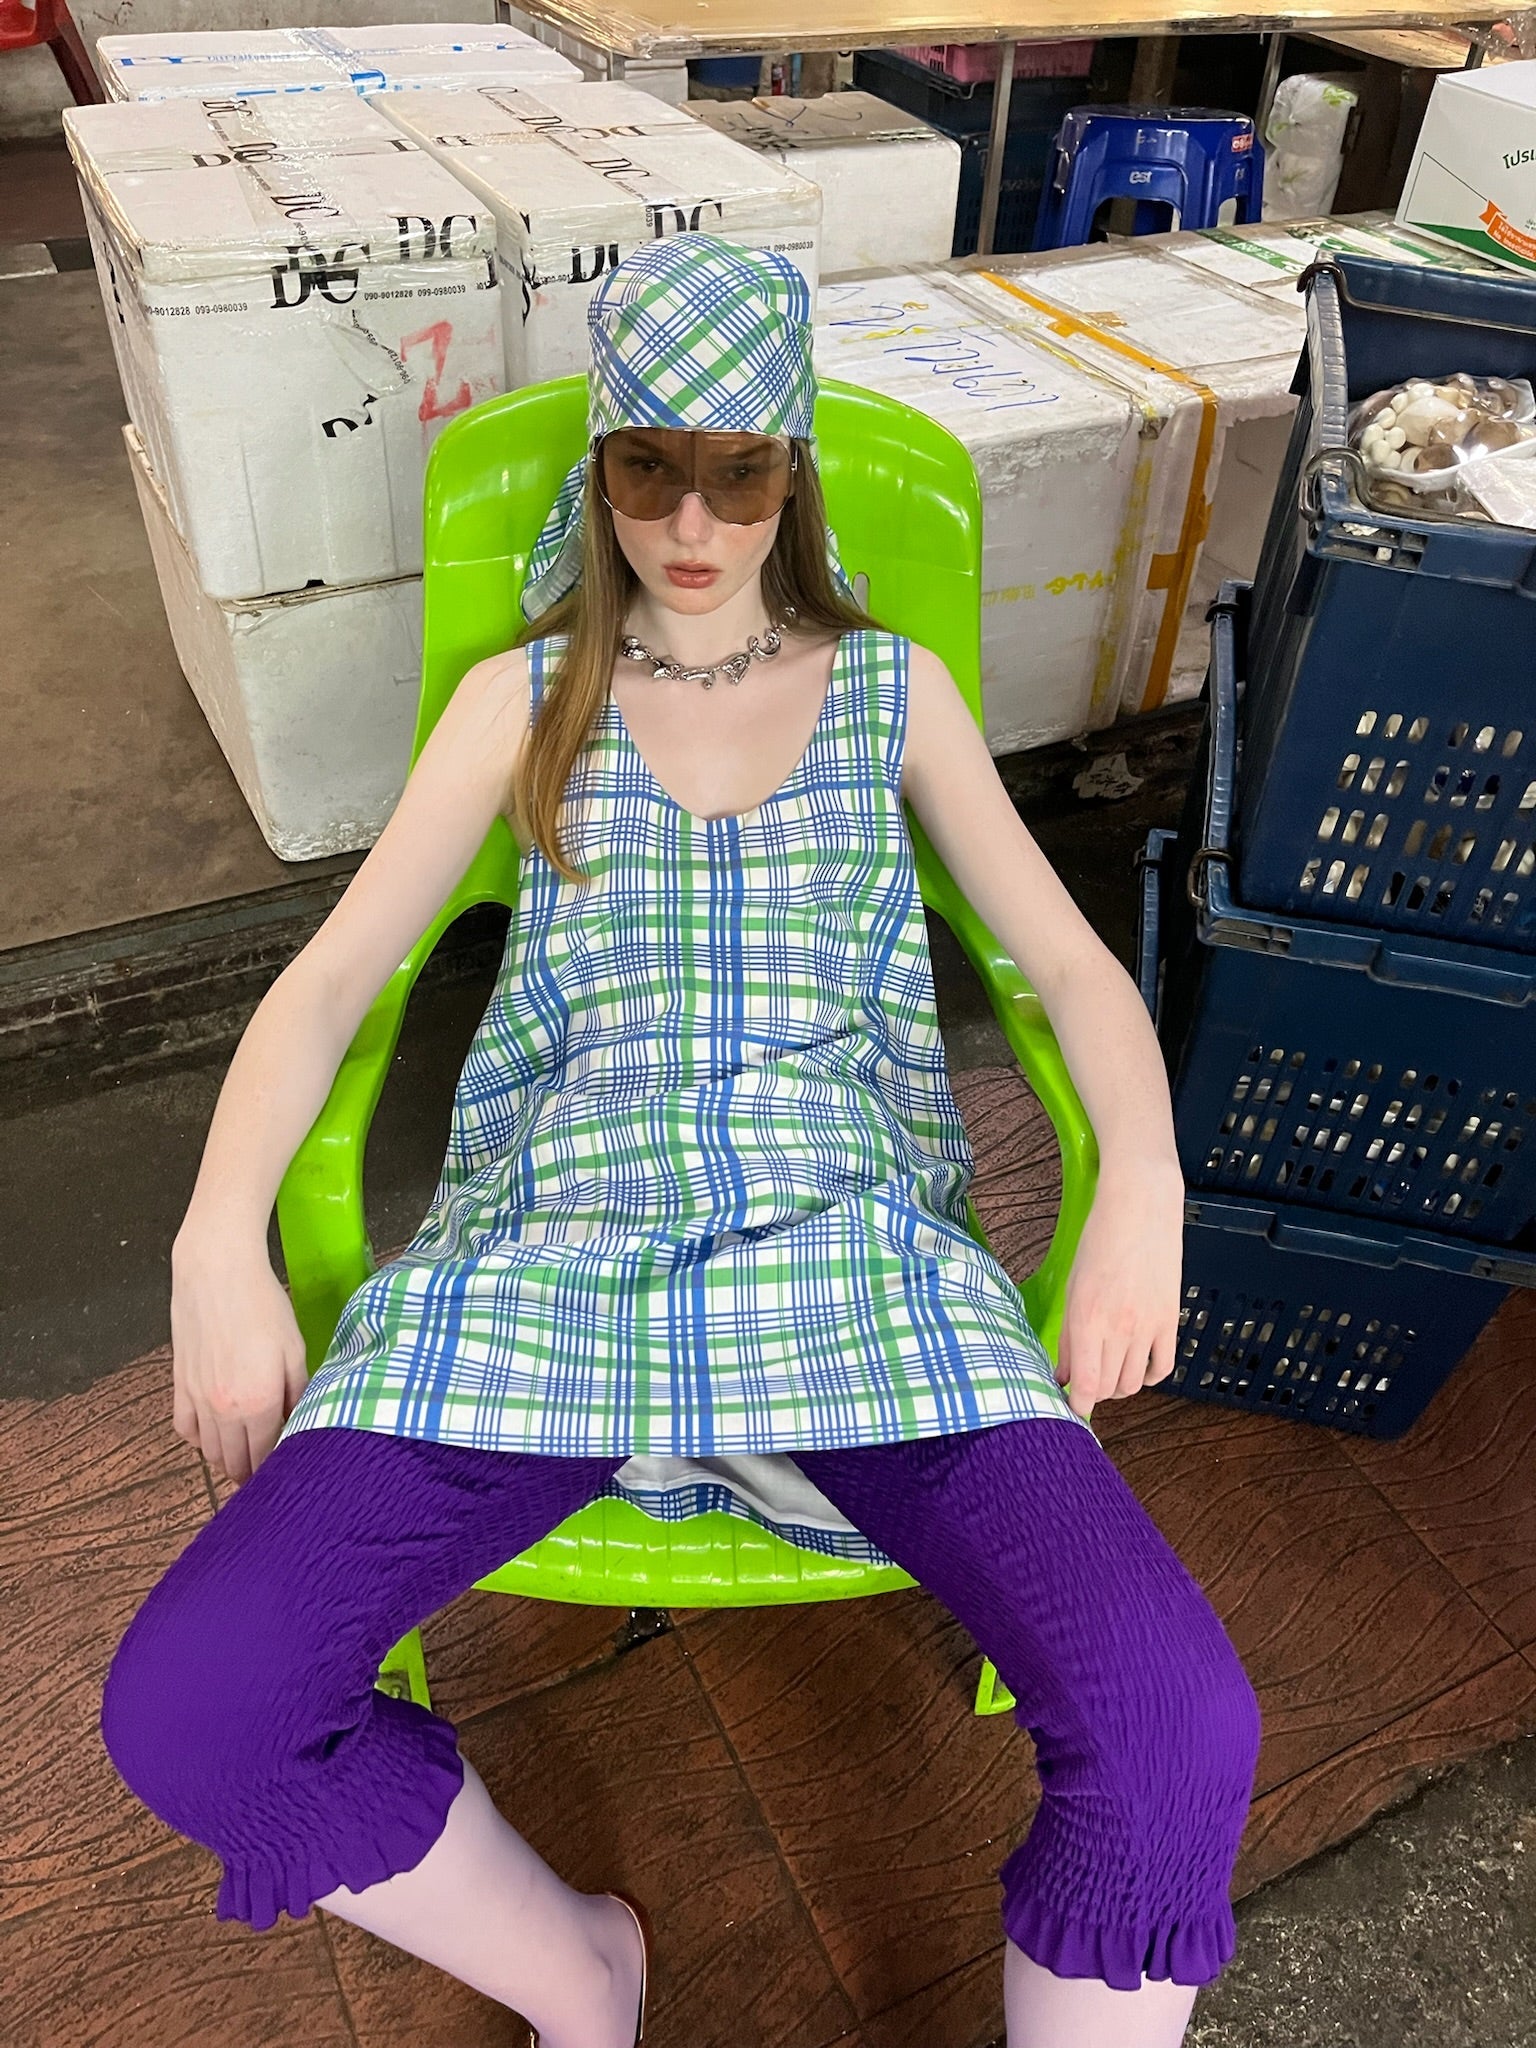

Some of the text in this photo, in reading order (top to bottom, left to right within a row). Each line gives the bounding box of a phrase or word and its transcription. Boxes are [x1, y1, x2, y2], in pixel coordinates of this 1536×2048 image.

[583, 158, 650, 180] DC
[387, 214, 477, 260] DC
[364, 290, 413, 300] 090-9012828
[417, 284, 466, 297] 099-0980039
